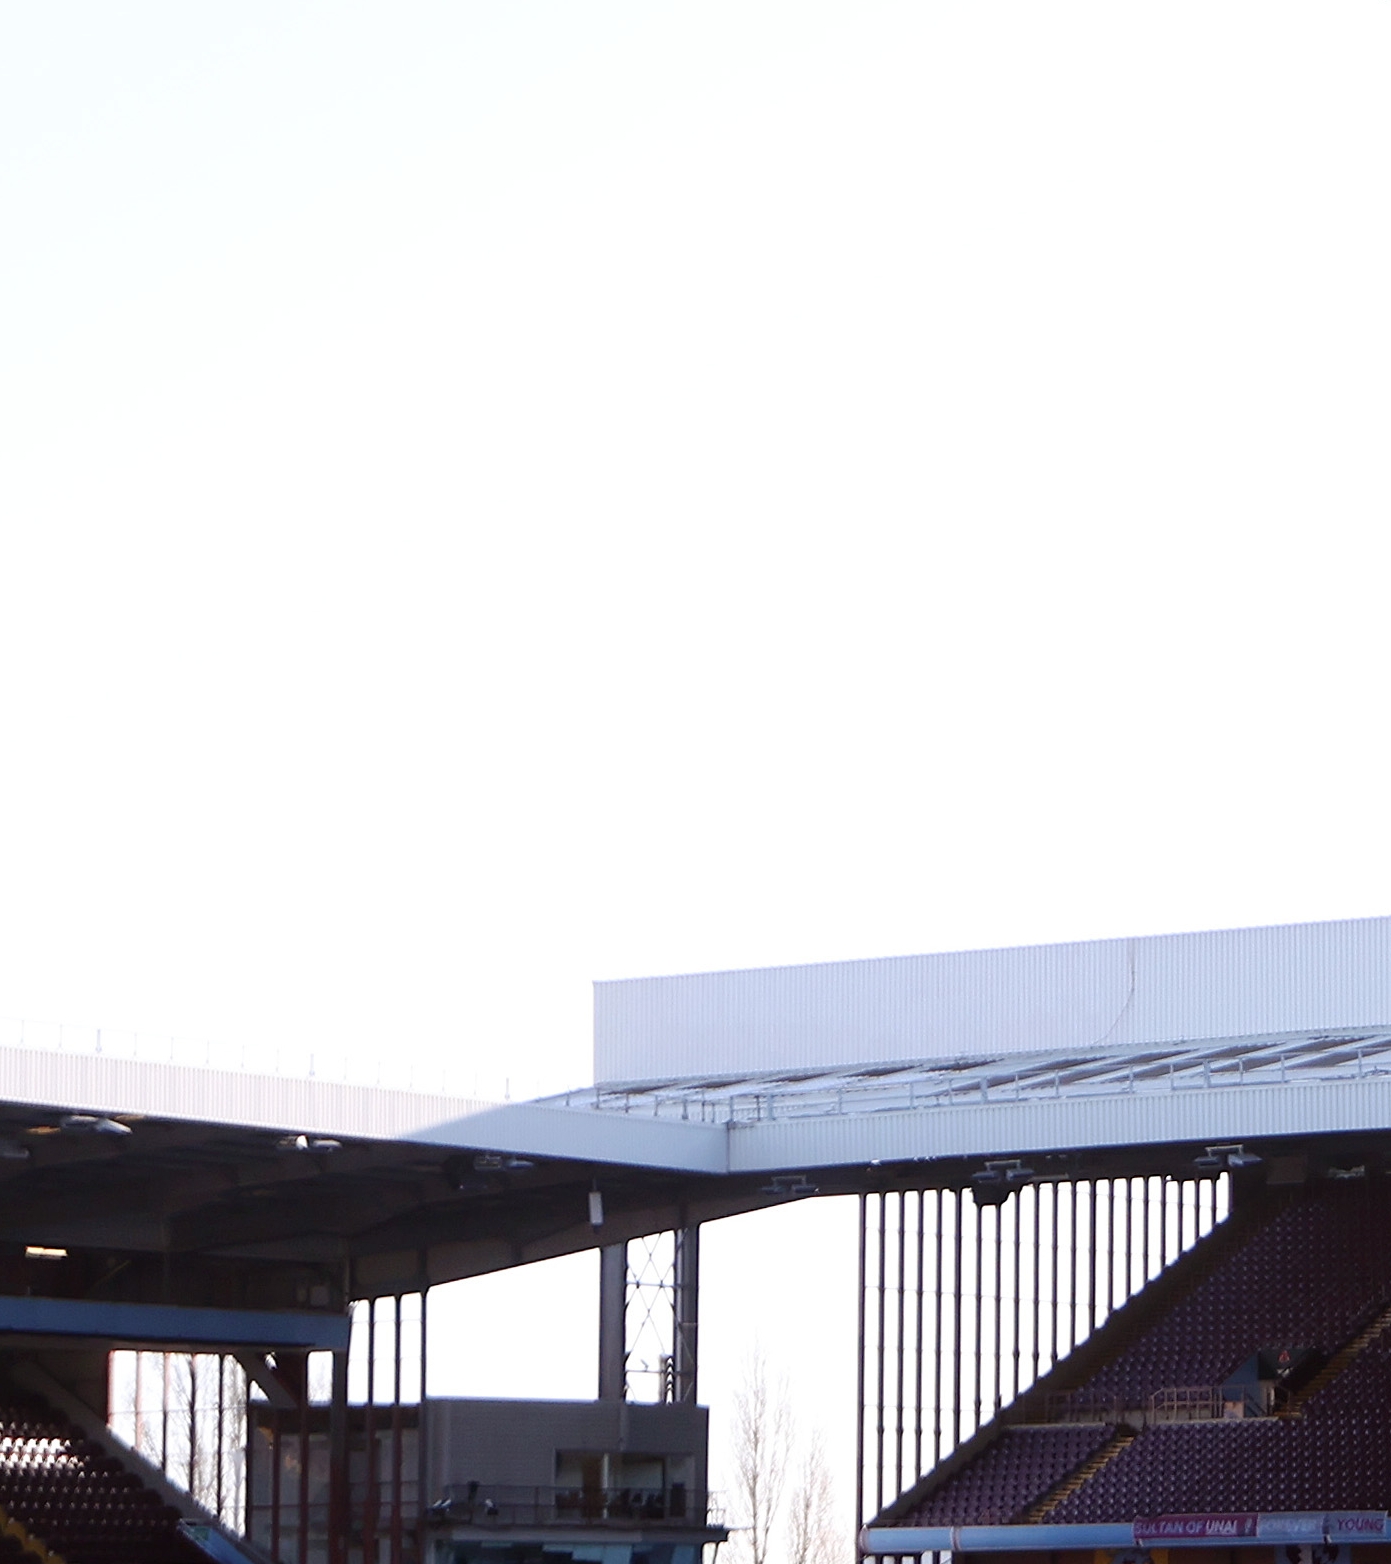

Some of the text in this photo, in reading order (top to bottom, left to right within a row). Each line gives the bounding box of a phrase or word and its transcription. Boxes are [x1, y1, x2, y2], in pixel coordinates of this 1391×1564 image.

[1185, 1520, 1205, 1535] OF
[1205, 1519, 1238, 1535] UNAI
[1337, 1517, 1384, 1532] YOUNG
